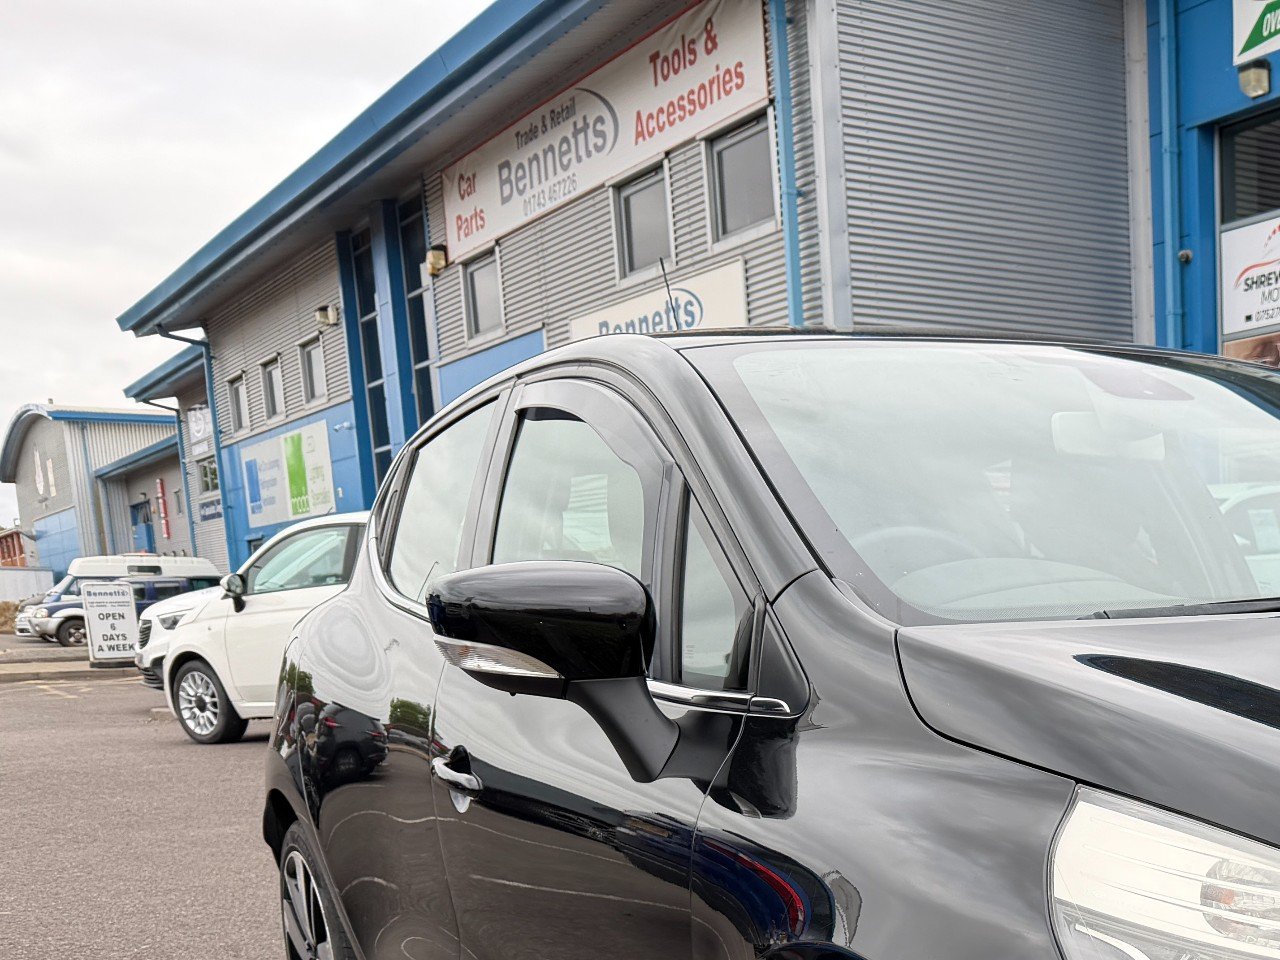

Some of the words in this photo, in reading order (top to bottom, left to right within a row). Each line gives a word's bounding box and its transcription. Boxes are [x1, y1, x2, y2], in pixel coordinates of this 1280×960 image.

[649, 34, 697, 87] Tools
[704, 17, 718, 55] &
[635, 61, 745, 146] Accessories
[514, 123, 539, 149] Trade
[541, 115, 548, 134] &
[550, 97, 576, 129] Retail
[498, 114, 608, 205] Bennetts
[457, 170, 477, 201] Car
[456, 206, 486, 242] Parts
[98, 612, 125, 620] OPEN
[110, 623, 116, 631] 6
[102, 633, 128, 641] DAYS
[106, 643, 136, 652] WEEK
